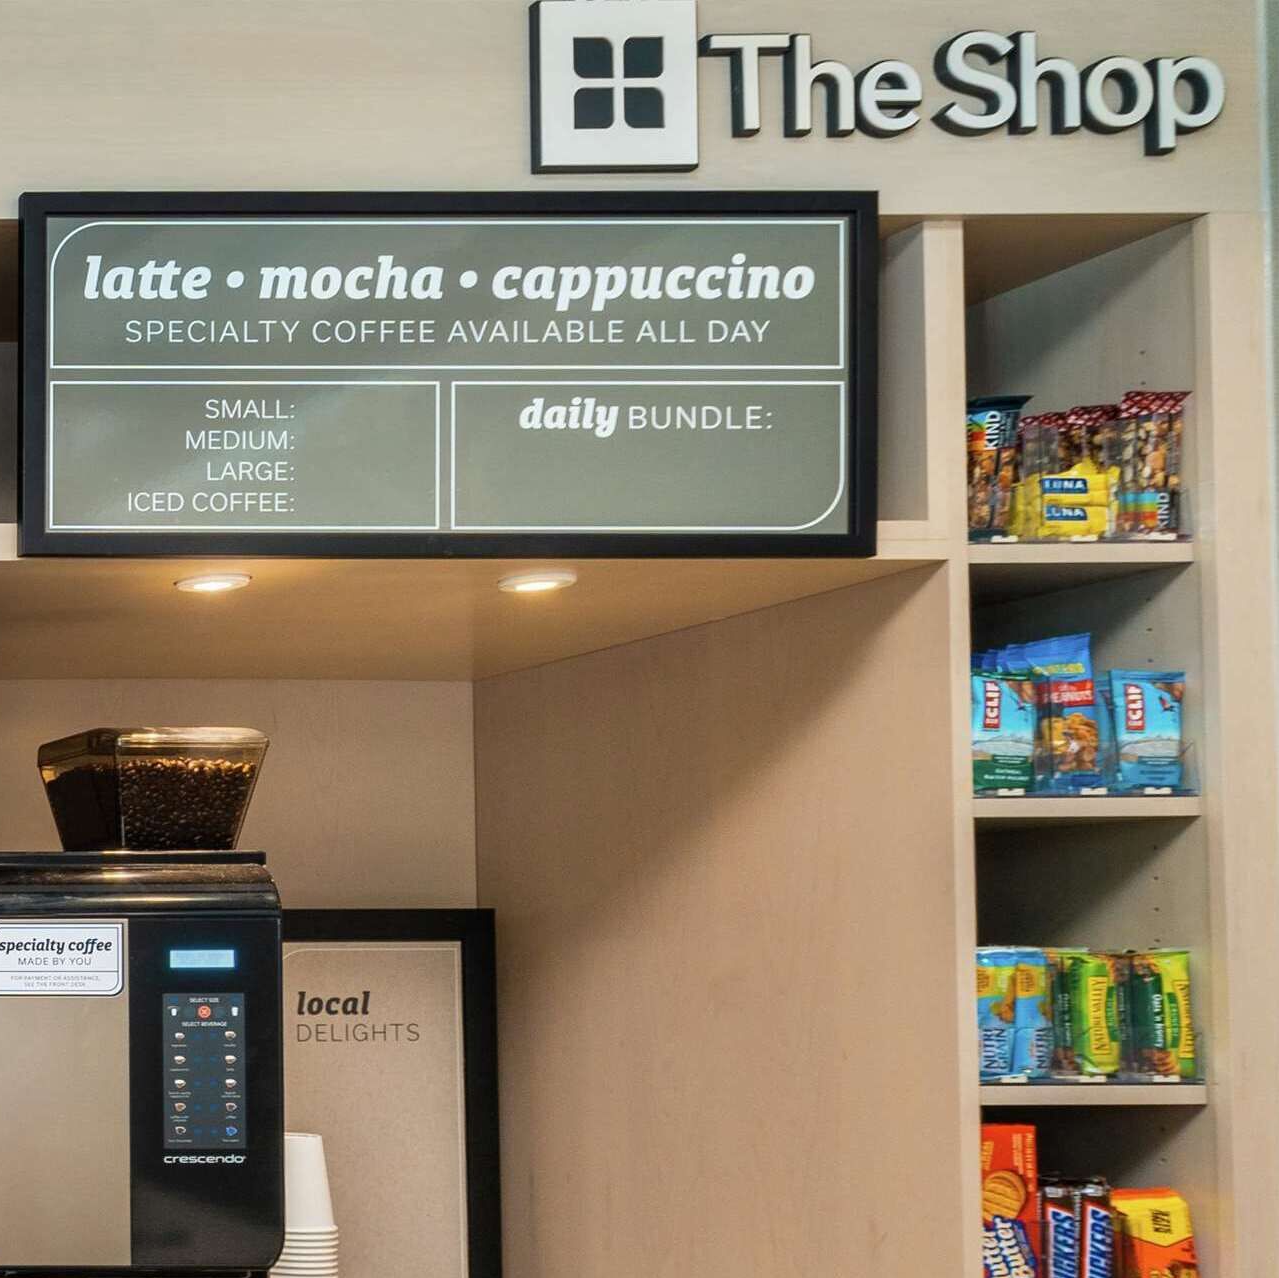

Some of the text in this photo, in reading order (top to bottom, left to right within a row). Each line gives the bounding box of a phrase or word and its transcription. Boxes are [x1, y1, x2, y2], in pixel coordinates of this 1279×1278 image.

[700, 30, 1225, 155] The Shop
[84, 254, 814, 311] latte mocha cappuccino
[125, 318, 771, 344] SPECIALTY COFFEE AVAILABLE ALL DAY
[205, 399, 296, 420] SMALL:
[520, 398, 773, 438] daily BUNDLE:
[185, 430, 296, 451] MEDIUM:
[985, 410, 1001, 450] KIND
[206, 461, 296, 482] LARGE:
[1043, 479, 1086, 490] LUNA
[127, 492, 296, 513] ICED COFFEE:
[68, 938, 113, 955] coffee
[18, 957, 92, 966] MADE BY YOU
[297, 991, 370, 1015] local
[297, 1023, 420, 1042] DELIGHTS
[982, 1027, 996, 1070] NUTRI
[163, 1153, 244, 1164] crescendo
